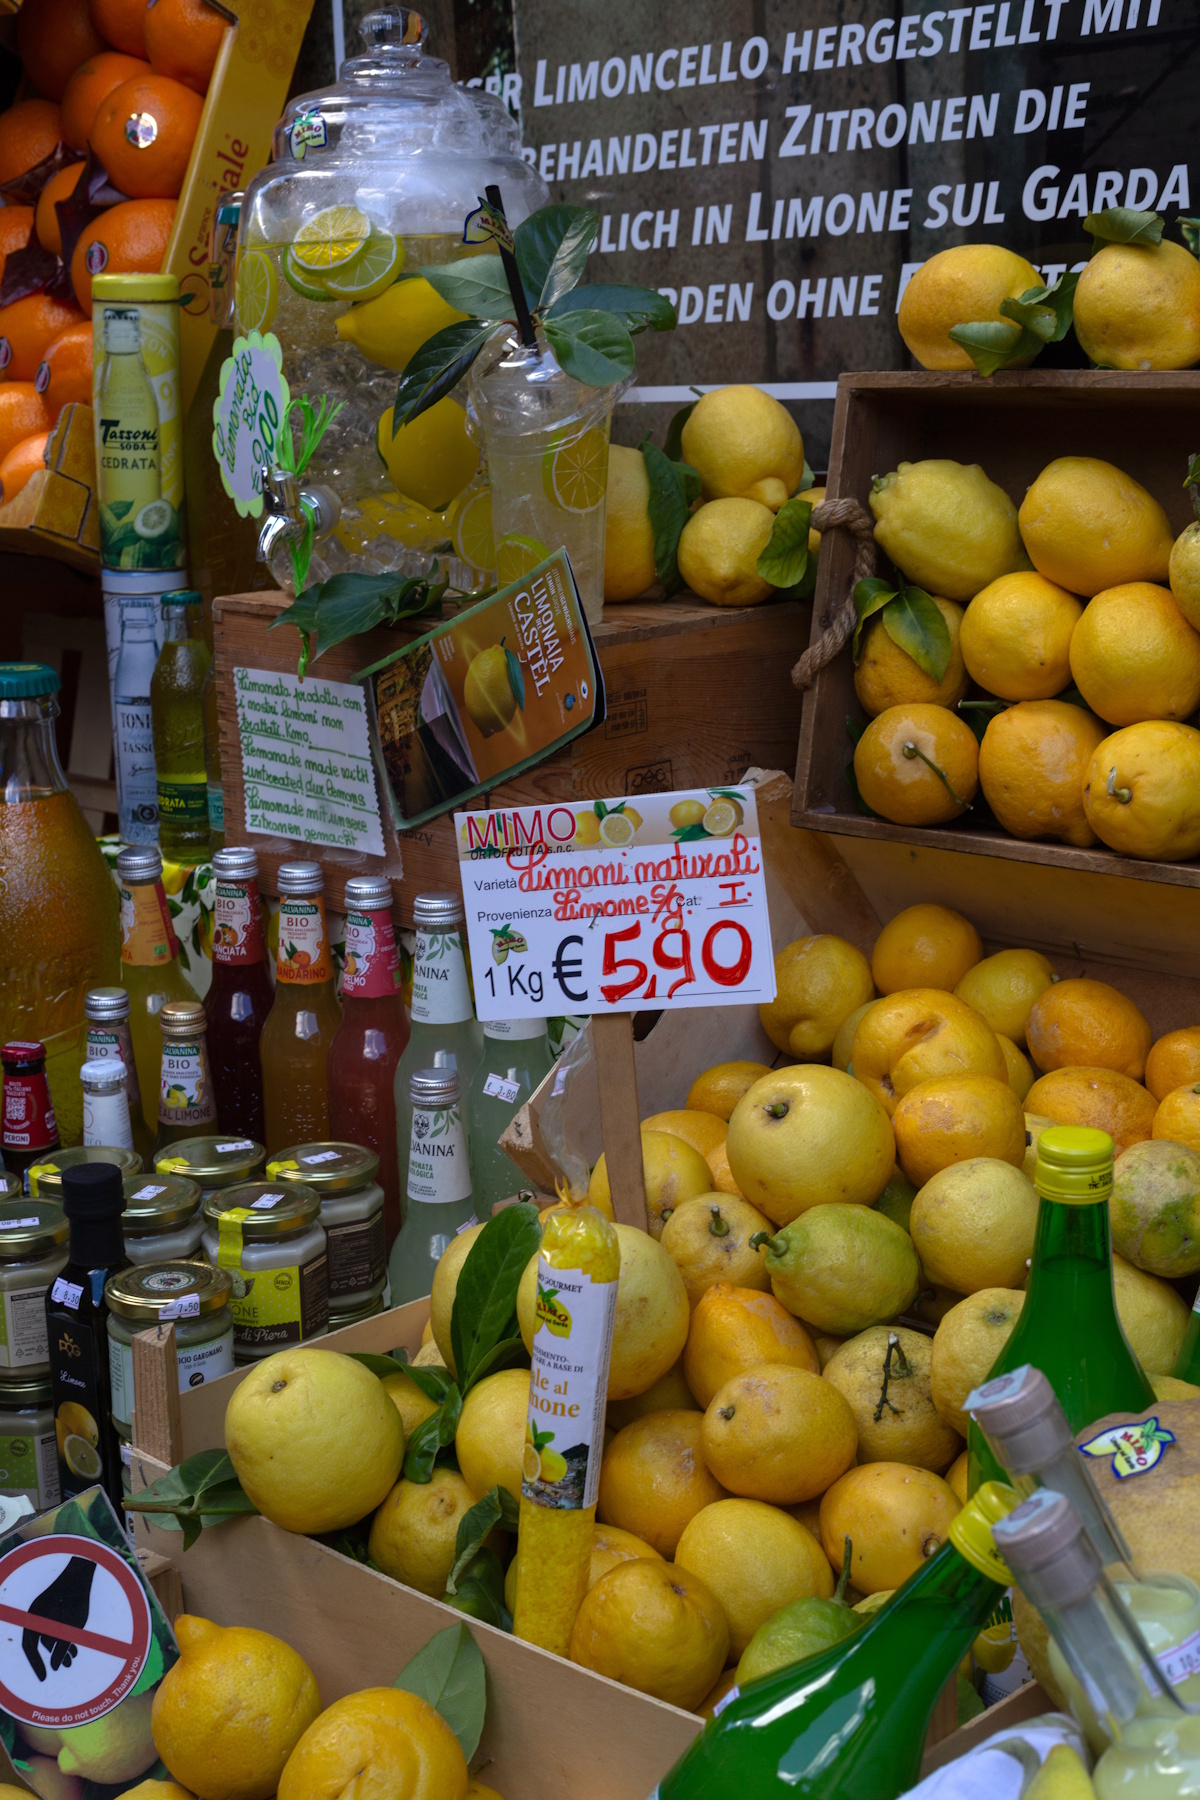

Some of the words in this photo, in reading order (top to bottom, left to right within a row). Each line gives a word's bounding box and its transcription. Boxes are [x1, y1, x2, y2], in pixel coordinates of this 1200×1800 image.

[533, 36, 769, 108] LIMONCELLO
[781, 0, 1071, 76] HERGESTELLT
[1081, 0, 1163, 37] MIT
[779, 95, 1001, 159] ZITRONEN
[1013, 82, 1091, 134] DIE
[691, 205, 732, 246] IN
[744, 190, 911, 243] LIMONE
[923, 182, 1006, 229] SUL
[1021, 164, 1192, 222] GARDA
[766, 274, 884, 320] OHNE
[100, 419, 158, 447] Tassoni
[120, 443, 147, 451] SODA
[101, 456, 157, 470] CEDRATA
[545, 571, 556, 595] LEMON
[530, 577, 565, 673] LIMONAIA
[235, 668, 292, 697] Limonata
[293, 685, 341, 711] prodotta
[304, 758, 340, 777] made
[466, 807, 578, 850] MIMO
[470, 845, 544, 861] ORTOFRUTTA
[547, 843, 575, 855] s.n.c.
[474, 878, 518, 892] Varietà
[506, 840, 629, 893] Limoni
[634, 832, 761, 886] naturali
[216, 899, 235, 910] BIO
[281, 905, 317, 914] GALVANINA
[477, 907, 553, 923] Provenienza
[553, 888, 650, 922] Limone
[286, 917, 309, 927] BIO
[496, 935, 525, 949] MIMO
[485, 967, 497, 997] 1
[508, 964, 545, 1002] Kg
[552, 935, 589, 1002] €
[600, 920, 753, 1004] 5,90
[89, 1046, 108, 1057] BIO
[163, 1046, 198, 1055] GALVANINA
[168, 1059, 191, 1069] BIO
[497, 1085, 516, 1100] 3.80
[163, 1108, 173, 1120] AL
[175, 1106, 212, 1121] LIMONE
[4, 1134, 29, 1143] PERONI
[544, 1276, 584, 1293] GOURMET
[63, 1290, 80, 1305] 8.30
[178, 1301, 199, 1313] 7.50
[552, 1319, 568, 1329] Garda
[254, 1328, 289, 1342] Piera
[193, 1345, 223, 1362] GARGNANO
[553, 1362, 573, 1373] BASE
[60, 1369, 87, 1389] Limone
[553, 1380, 568, 1395] al
[1118, 1430, 1149, 1468] MIMO
[31, 1709, 60, 1723] Please
[62, 1713, 73, 1723] do
[74, 1708, 90, 1721] not
[89, 1697, 115, 1715] touch.
[111, 1673, 133, 1698] Thank
[129, 1654, 142, 1675] you.
